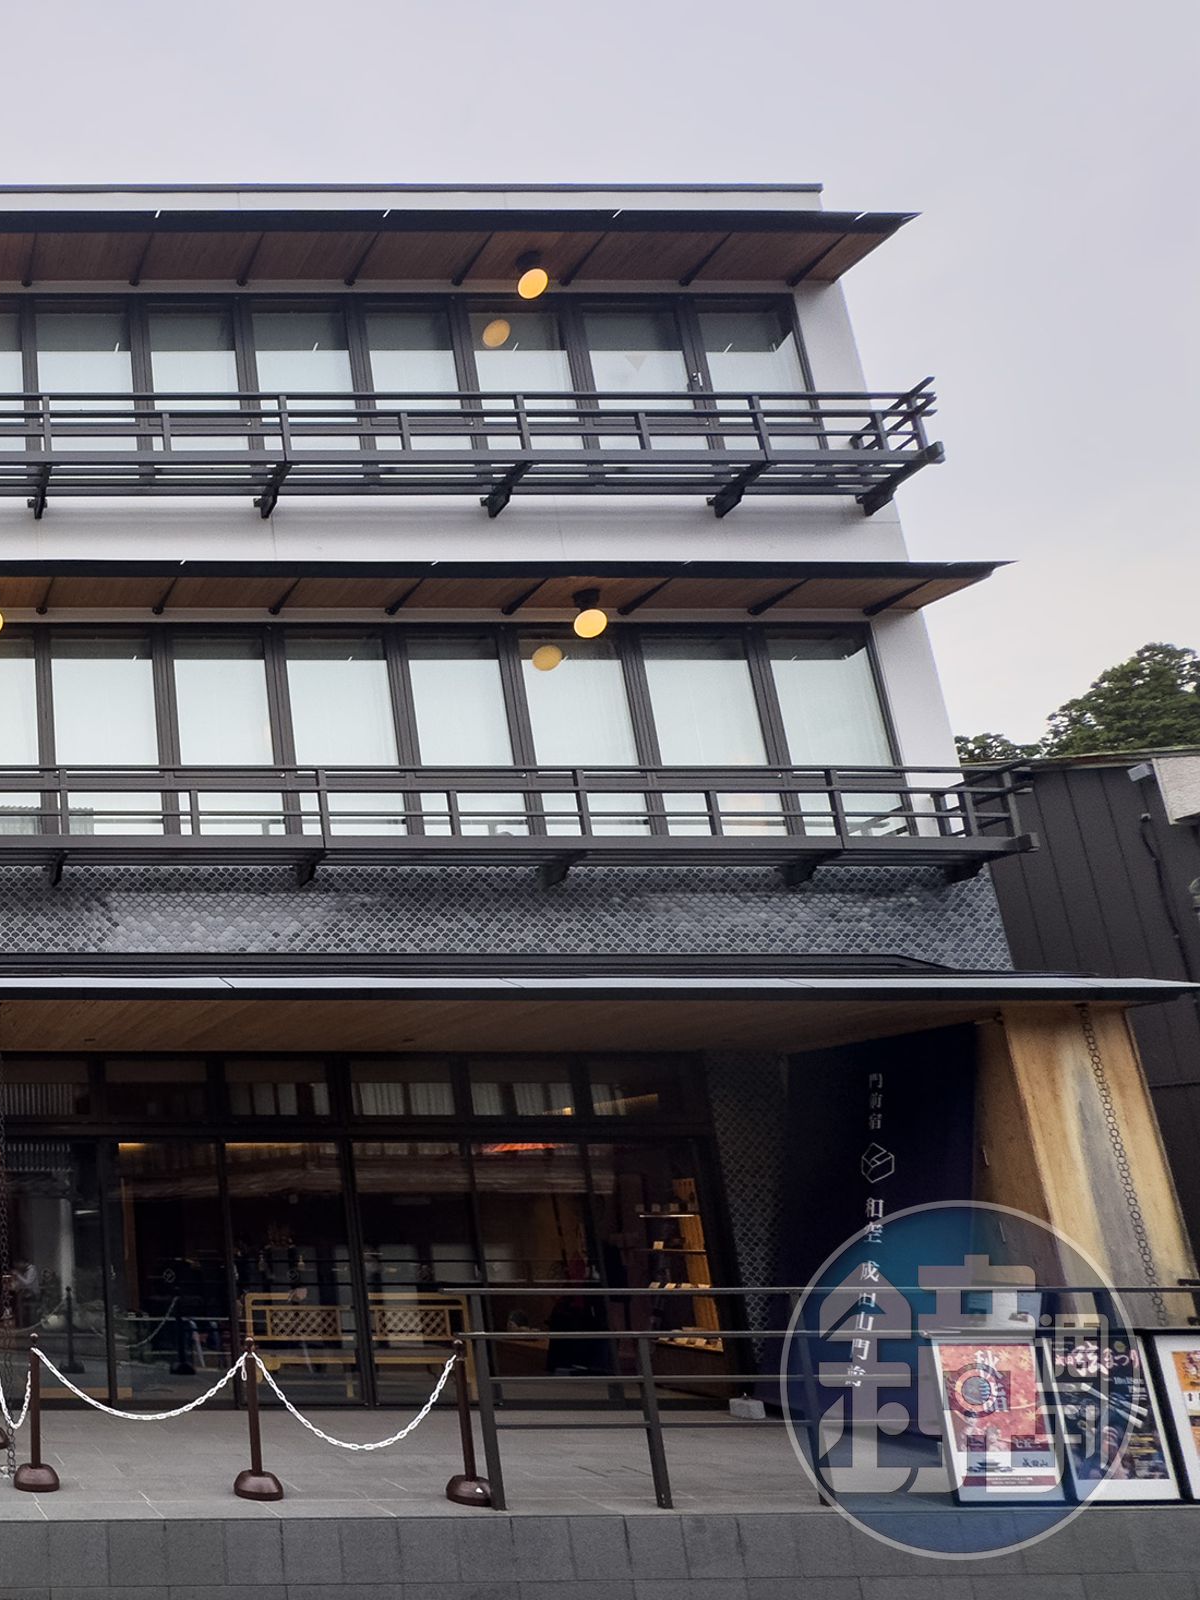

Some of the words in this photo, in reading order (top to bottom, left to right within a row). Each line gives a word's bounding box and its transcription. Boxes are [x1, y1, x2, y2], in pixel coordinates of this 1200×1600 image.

[868, 1073, 884, 1130] 門前宿
[864, 1197, 885, 1243] 和空
